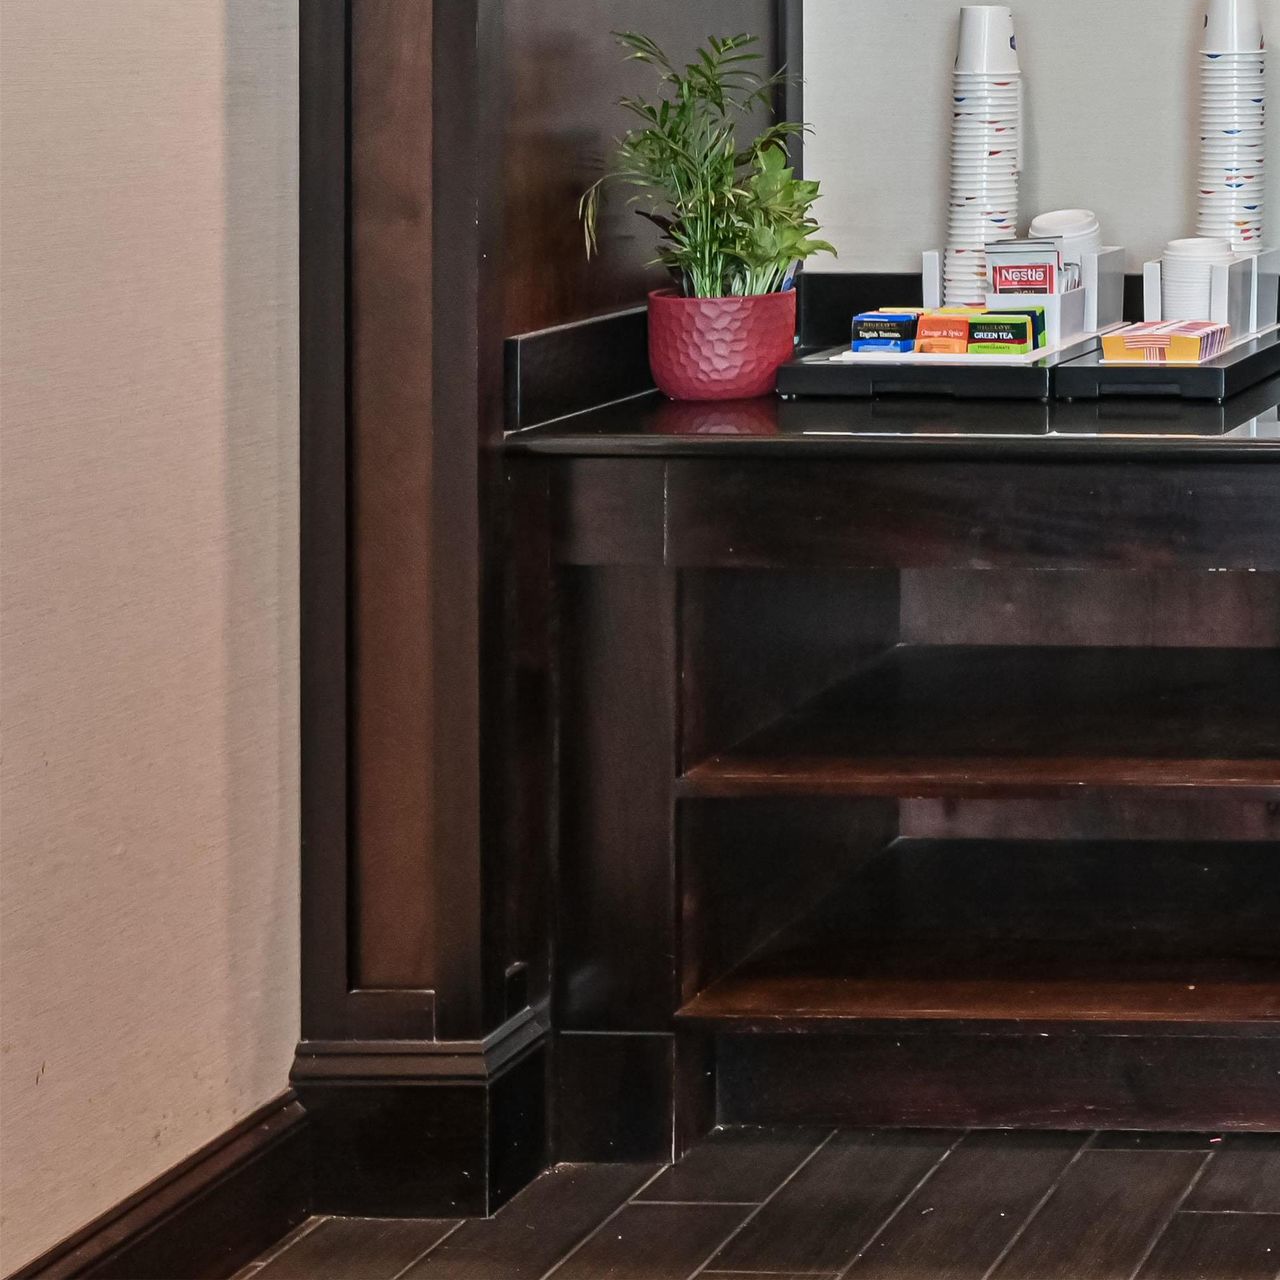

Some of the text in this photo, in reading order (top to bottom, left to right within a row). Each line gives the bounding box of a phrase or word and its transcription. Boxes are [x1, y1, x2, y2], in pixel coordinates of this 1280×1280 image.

[948, 329, 964, 338] Spice
[973, 331, 1014, 340] GREEN TEA
